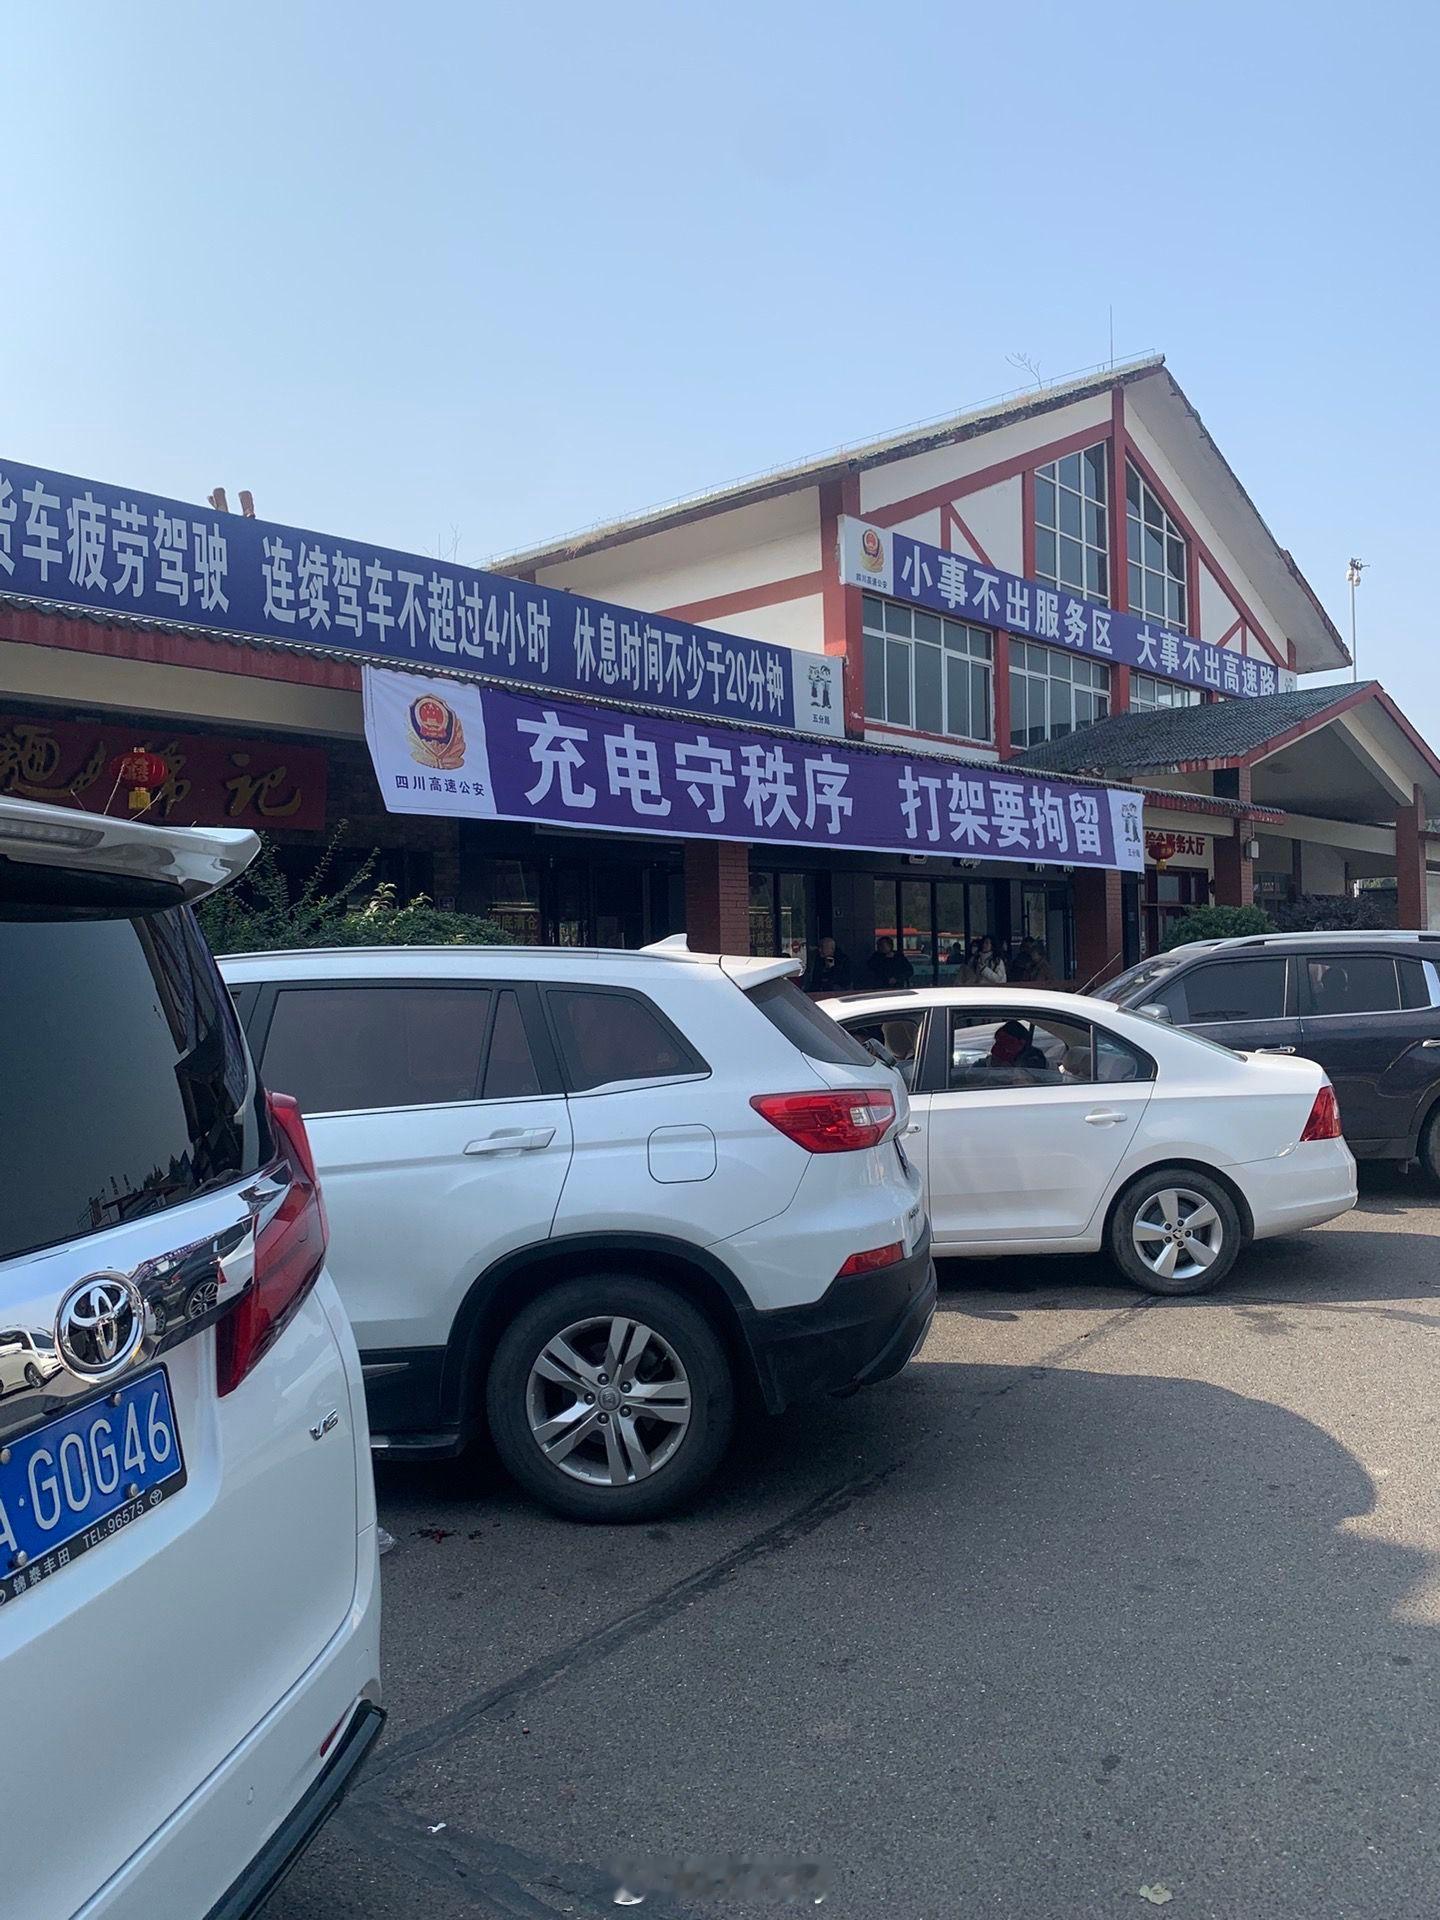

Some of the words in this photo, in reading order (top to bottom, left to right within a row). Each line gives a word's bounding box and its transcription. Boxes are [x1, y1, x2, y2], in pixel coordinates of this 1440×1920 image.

[262, 536, 550, 674] 连续驾车不超过4小时
[574, 607, 784, 717] 休息时间不少于20分钟
[901, 545, 1113, 655] 小事不出服务区
[1137, 625, 1276, 696] 大事不出高速路
[395, 775, 485, 797] 四川高速公安
[516, 711, 854, 835] 充电守秩序
[899, 766, 1102, 857] 打架要拘留
[309, 1408, 339, 1441] V6
[83, 1501, 144, 1549] TEL:96575
